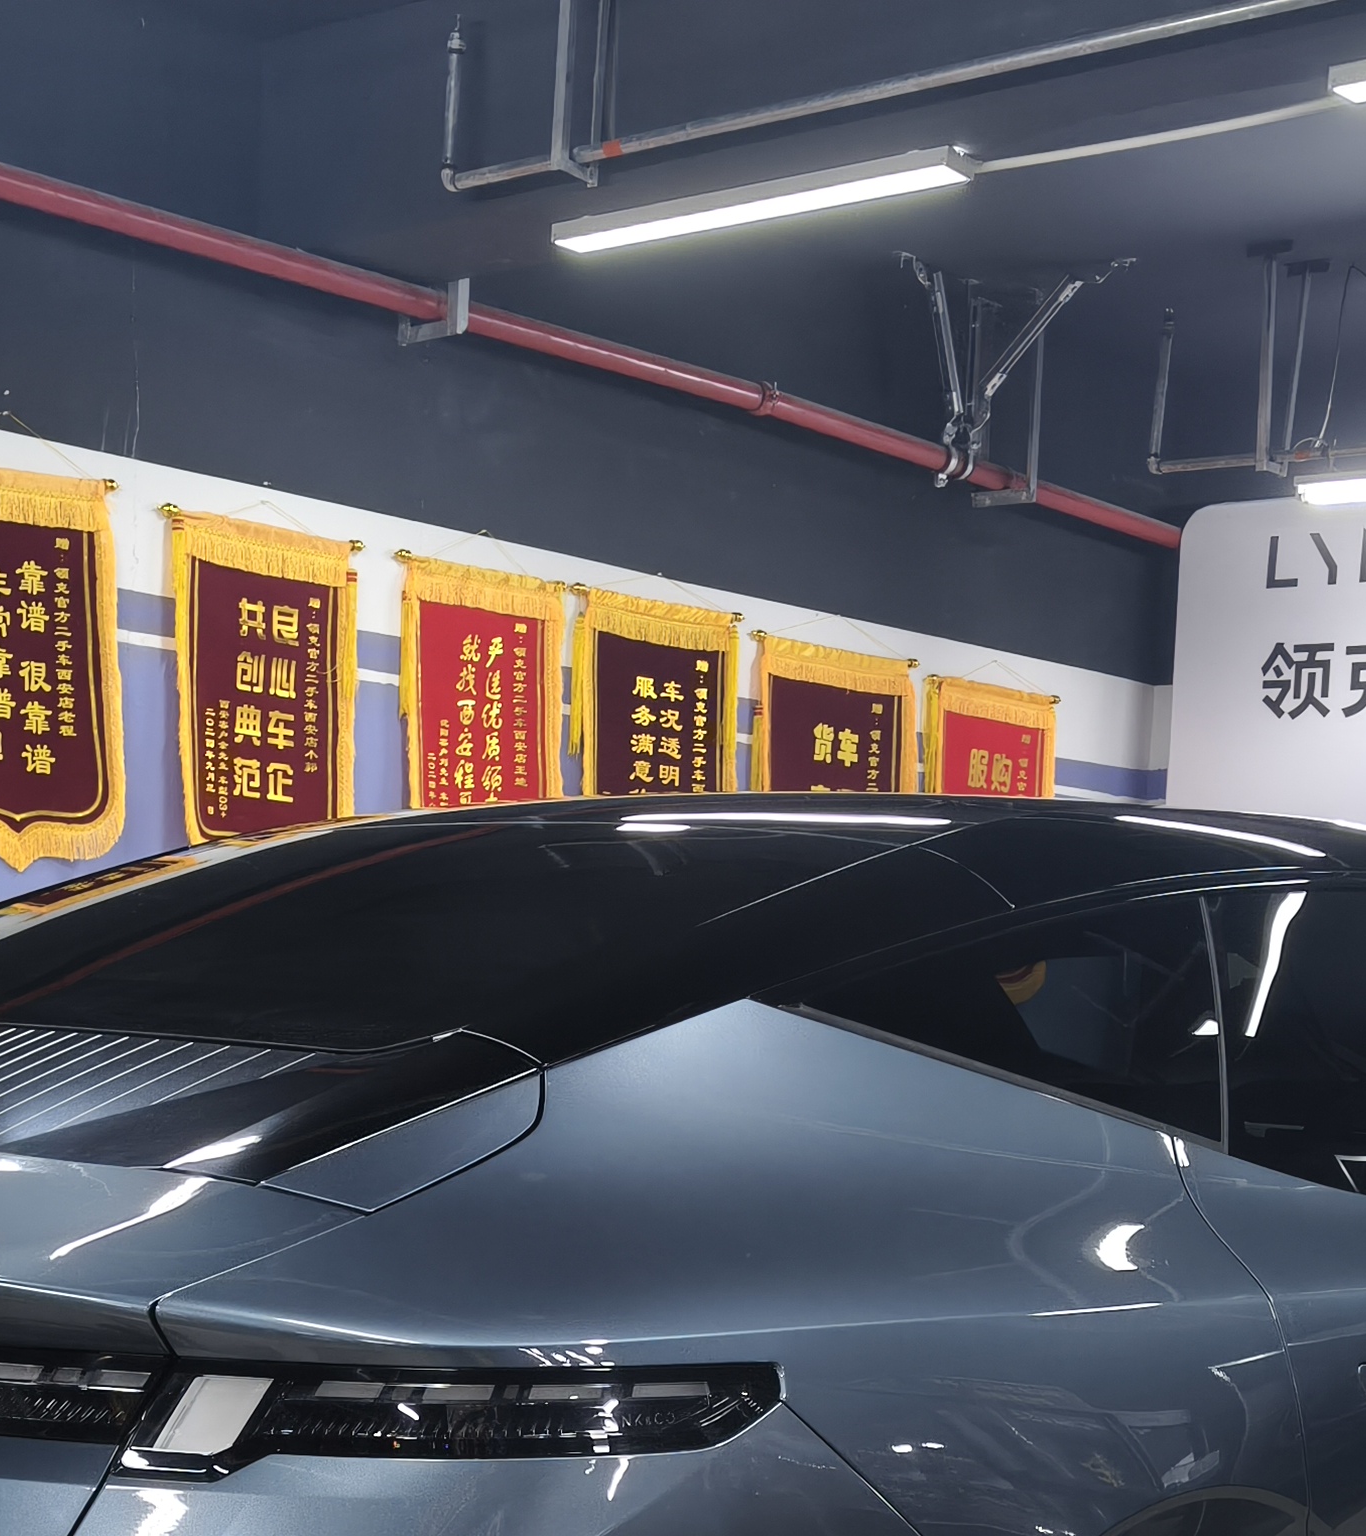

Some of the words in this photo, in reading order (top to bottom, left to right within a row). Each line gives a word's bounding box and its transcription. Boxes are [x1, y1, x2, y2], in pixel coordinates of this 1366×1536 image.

[15, 560, 50, 633] 靠谱
[19, 660, 56, 775] 很靠谱
[233, 597, 267, 800] 共创典范
[266, 605, 299, 803] 良心车企
[629, 675, 658, 794] 服务满意
[658, 681, 684, 787] 车况透明
[968, 748, 989, 788] 服
[991, 754, 1013, 793] 购
